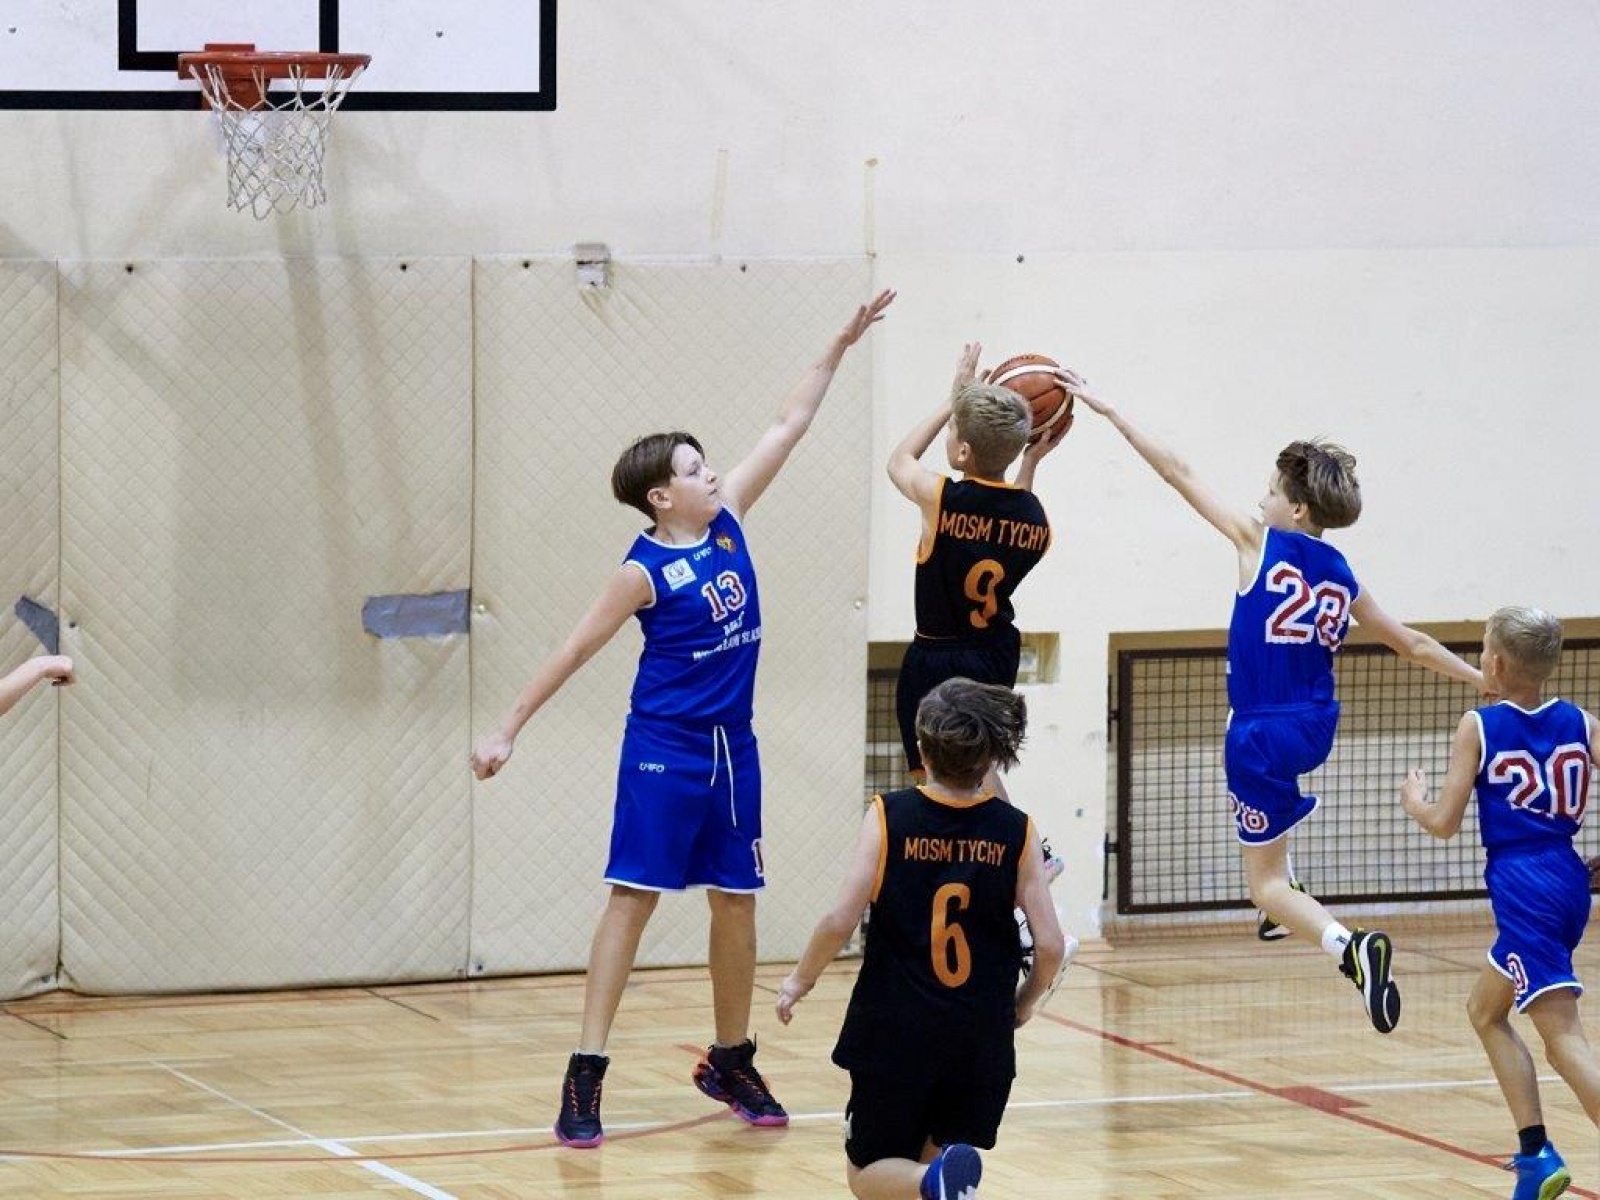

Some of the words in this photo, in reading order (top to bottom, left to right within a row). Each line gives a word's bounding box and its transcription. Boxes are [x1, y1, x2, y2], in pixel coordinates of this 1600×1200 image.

[940, 510, 993, 542] MOSM
[997, 519, 1049, 550] TYCHY
[701, 570, 747, 622] 13
[964, 558, 1005, 629] 9
[1265, 560, 1350, 652] 28
[1487, 742, 1590, 826] 20
[904, 836, 952, 861] MOSM
[955, 840, 1007, 867] TYCHY
[931, 882, 972, 988] 6
